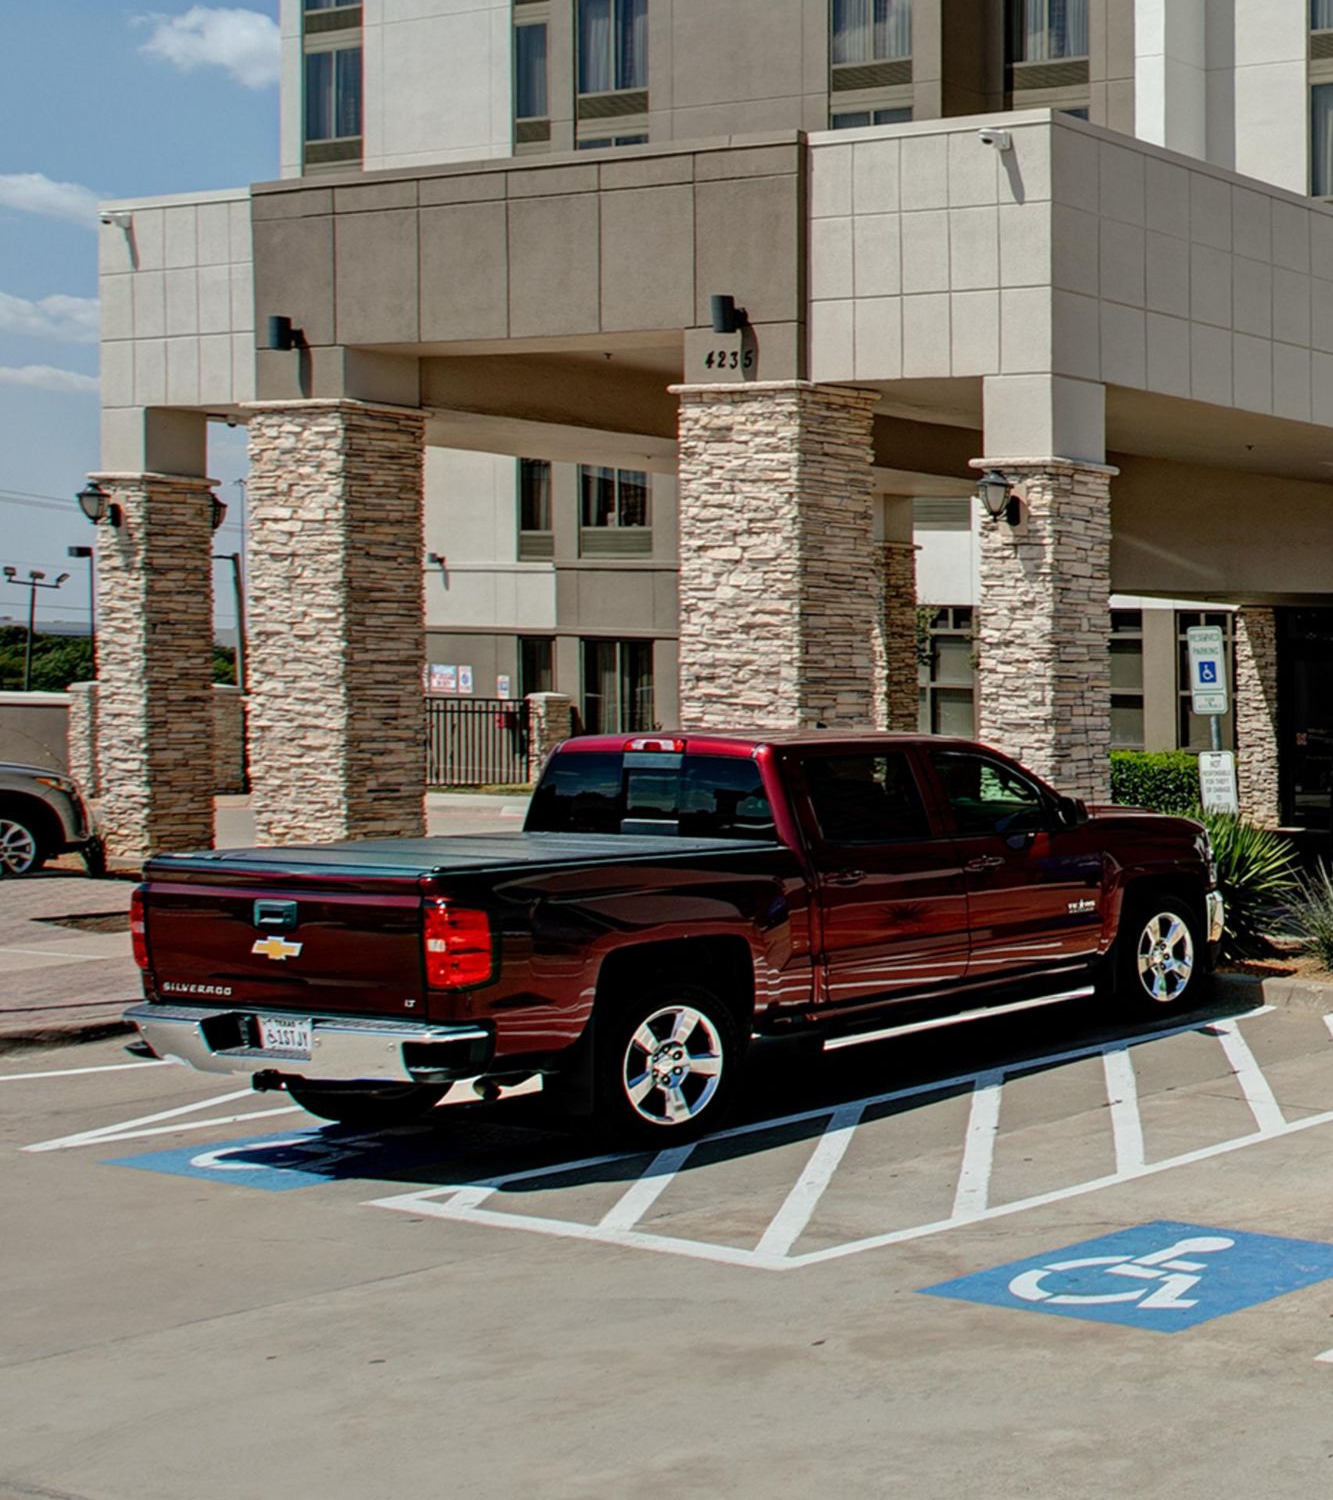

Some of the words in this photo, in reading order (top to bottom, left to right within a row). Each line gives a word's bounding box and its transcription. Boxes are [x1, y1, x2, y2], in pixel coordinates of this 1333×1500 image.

[705, 350, 753, 369] 4235
[1192, 646, 1219, 655] PARKING
[163, 981, 232, 996] SILVERADO
